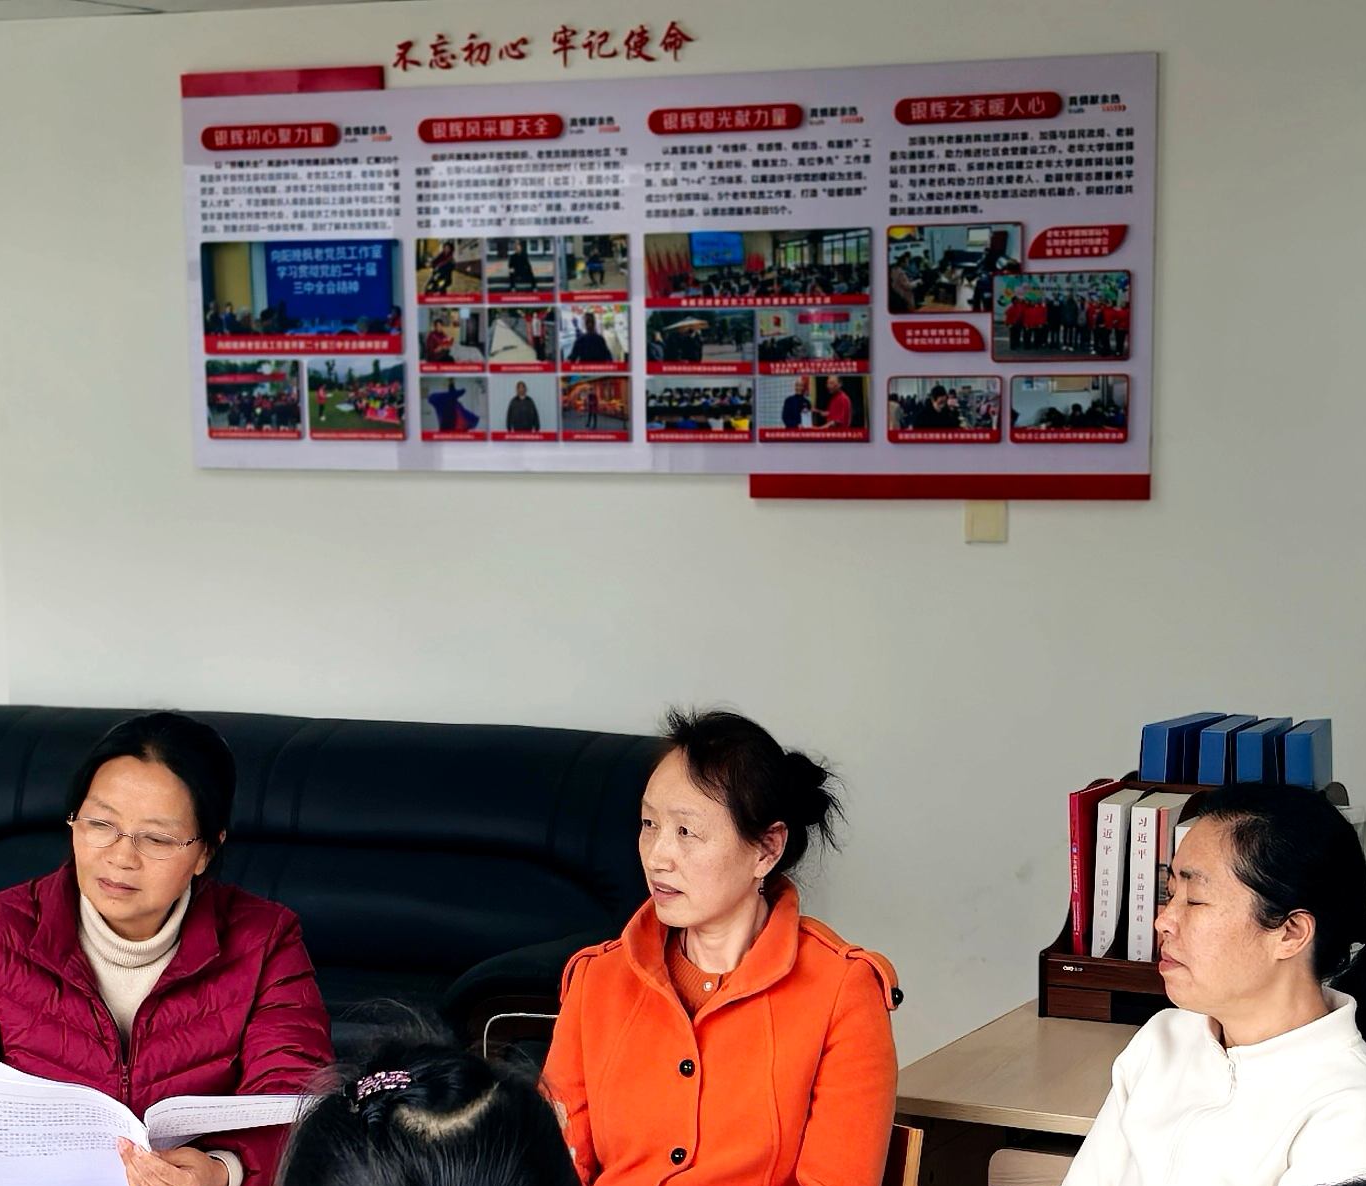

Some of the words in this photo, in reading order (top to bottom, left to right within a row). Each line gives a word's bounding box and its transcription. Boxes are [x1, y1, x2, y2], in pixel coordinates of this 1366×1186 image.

[393, 33, 529, 71] 不忘初心
[552, 21, 695, 68] 牢记使命
[910, 97, 1045, 120] 银辉之家暖人心
[214, 126, 324, 146] 银辉初心聚力量
[1103, 813, 1113, 855] 习近平
[1137, 817, 1148, 859] 习近平
